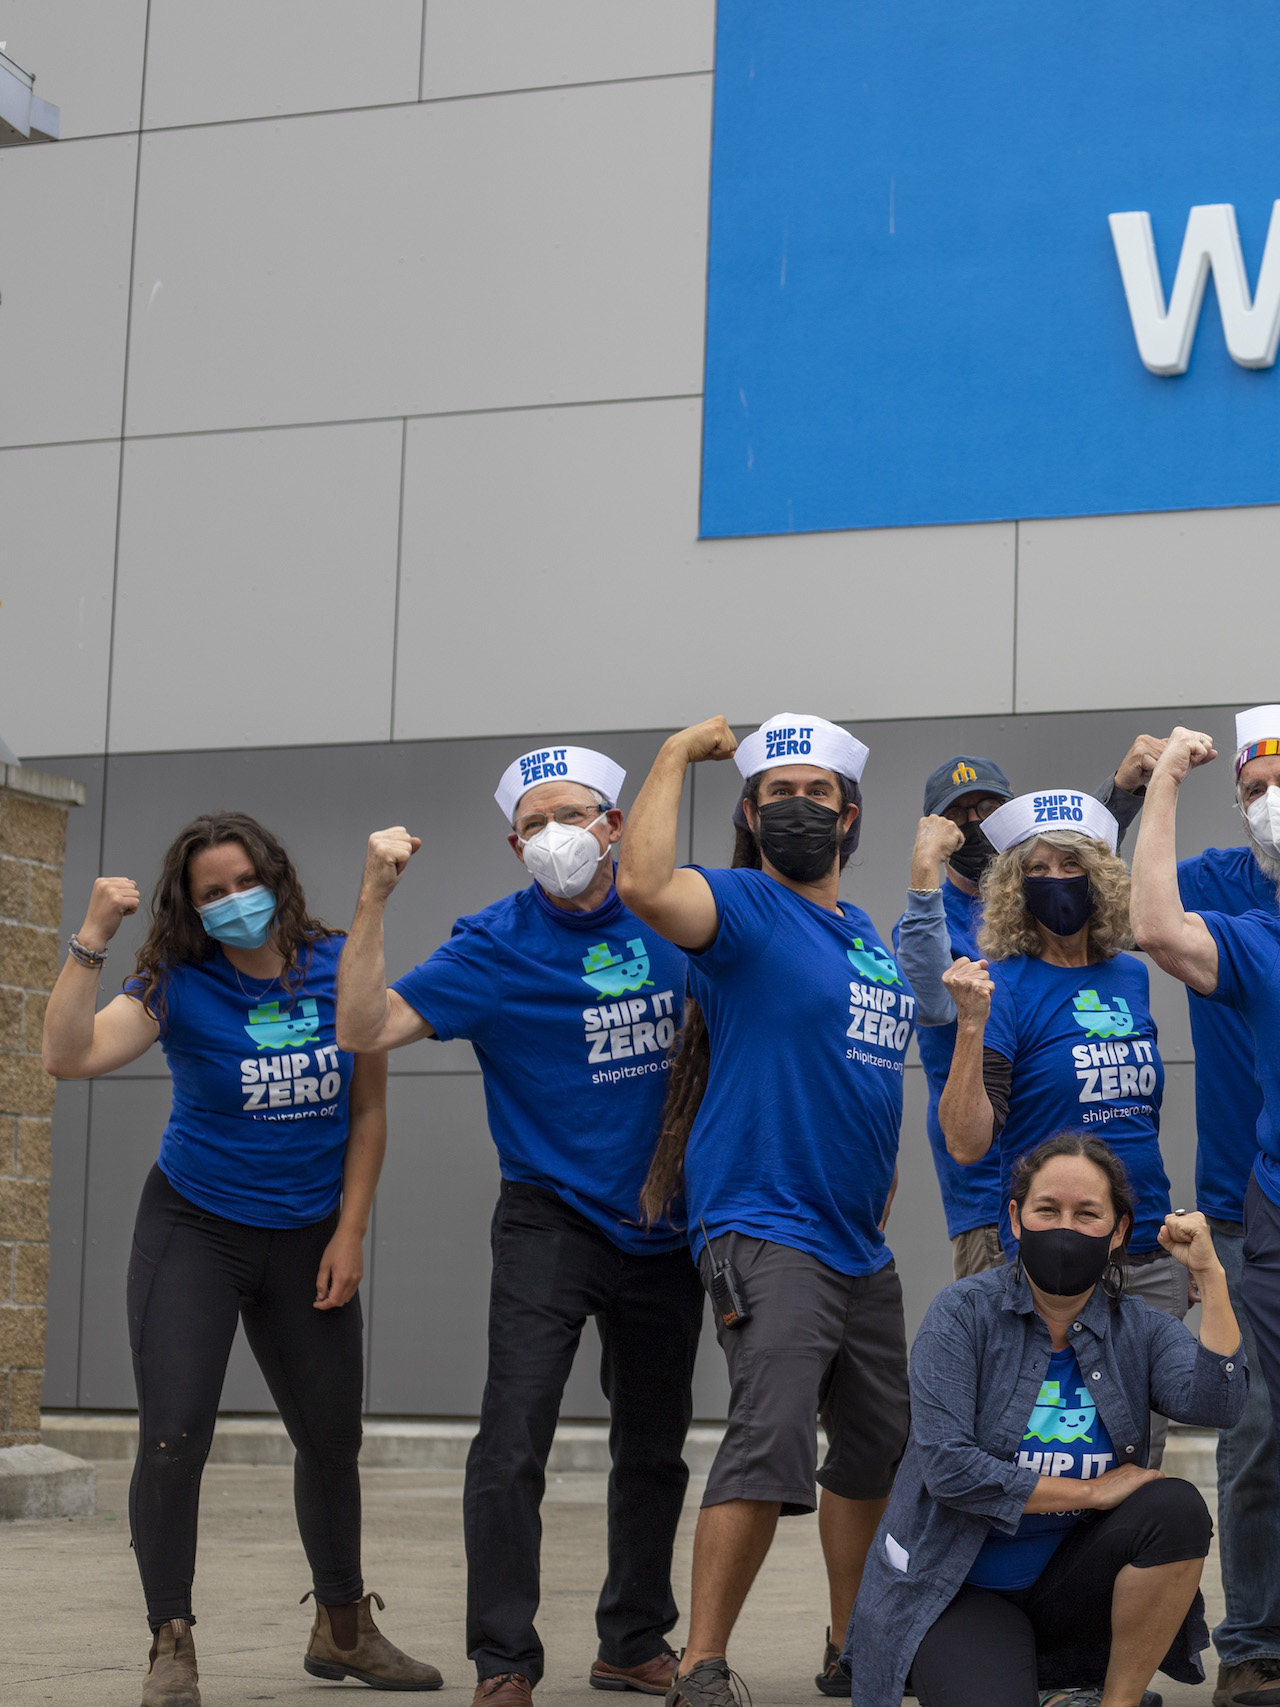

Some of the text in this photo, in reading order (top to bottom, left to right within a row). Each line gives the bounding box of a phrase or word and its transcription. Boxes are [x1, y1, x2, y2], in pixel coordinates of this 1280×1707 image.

[766, 727, 814, 743] SHIP IT
[520, 749, 567, 771] SHIP IT
[766, 740, 811, 760] ZERO
[521, 762, 568, 787] ZERO
[1033, 795, 1083, 808] SHIP IT
[1033, 806, 1083, 823] ZERO
[582, 990, 674, 1032] SHIP IT
[849, 981, 915, 1019] SHIP IT
[585, 1017, 675, 1065] ZERO
[846, 1005, 910, 1051] ZERO
[240, 1044, 339, 1084] SHIP IT
[1072, 1040, 1154, 1069] SHIP IT
[592, 1058, 677, 1084] shipitzero.o
[1076, 1064, 1157, 1103] ZERO
[241, 1071, 342, 1111] ZERO
[1014, 1450, 1113, 1480] HIP IT
